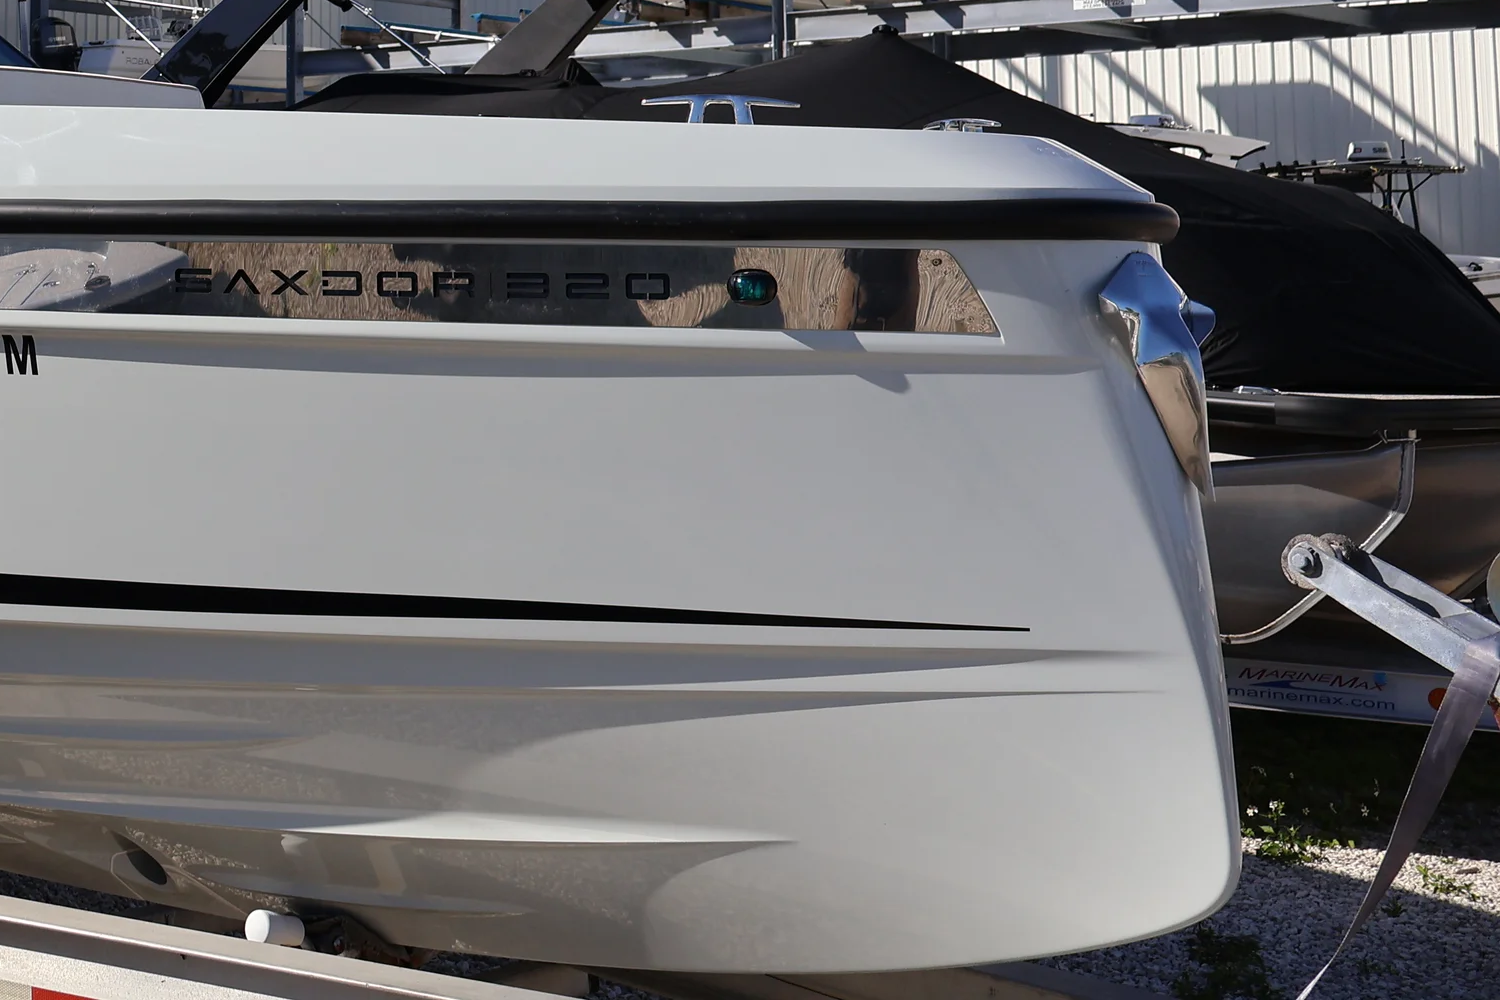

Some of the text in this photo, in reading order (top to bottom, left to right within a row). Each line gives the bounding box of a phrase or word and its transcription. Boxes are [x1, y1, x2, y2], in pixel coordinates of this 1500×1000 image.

[174, 267, 671, 301] SAXDOR 320
[1228, 686, 1395, 711] marinemax.com
